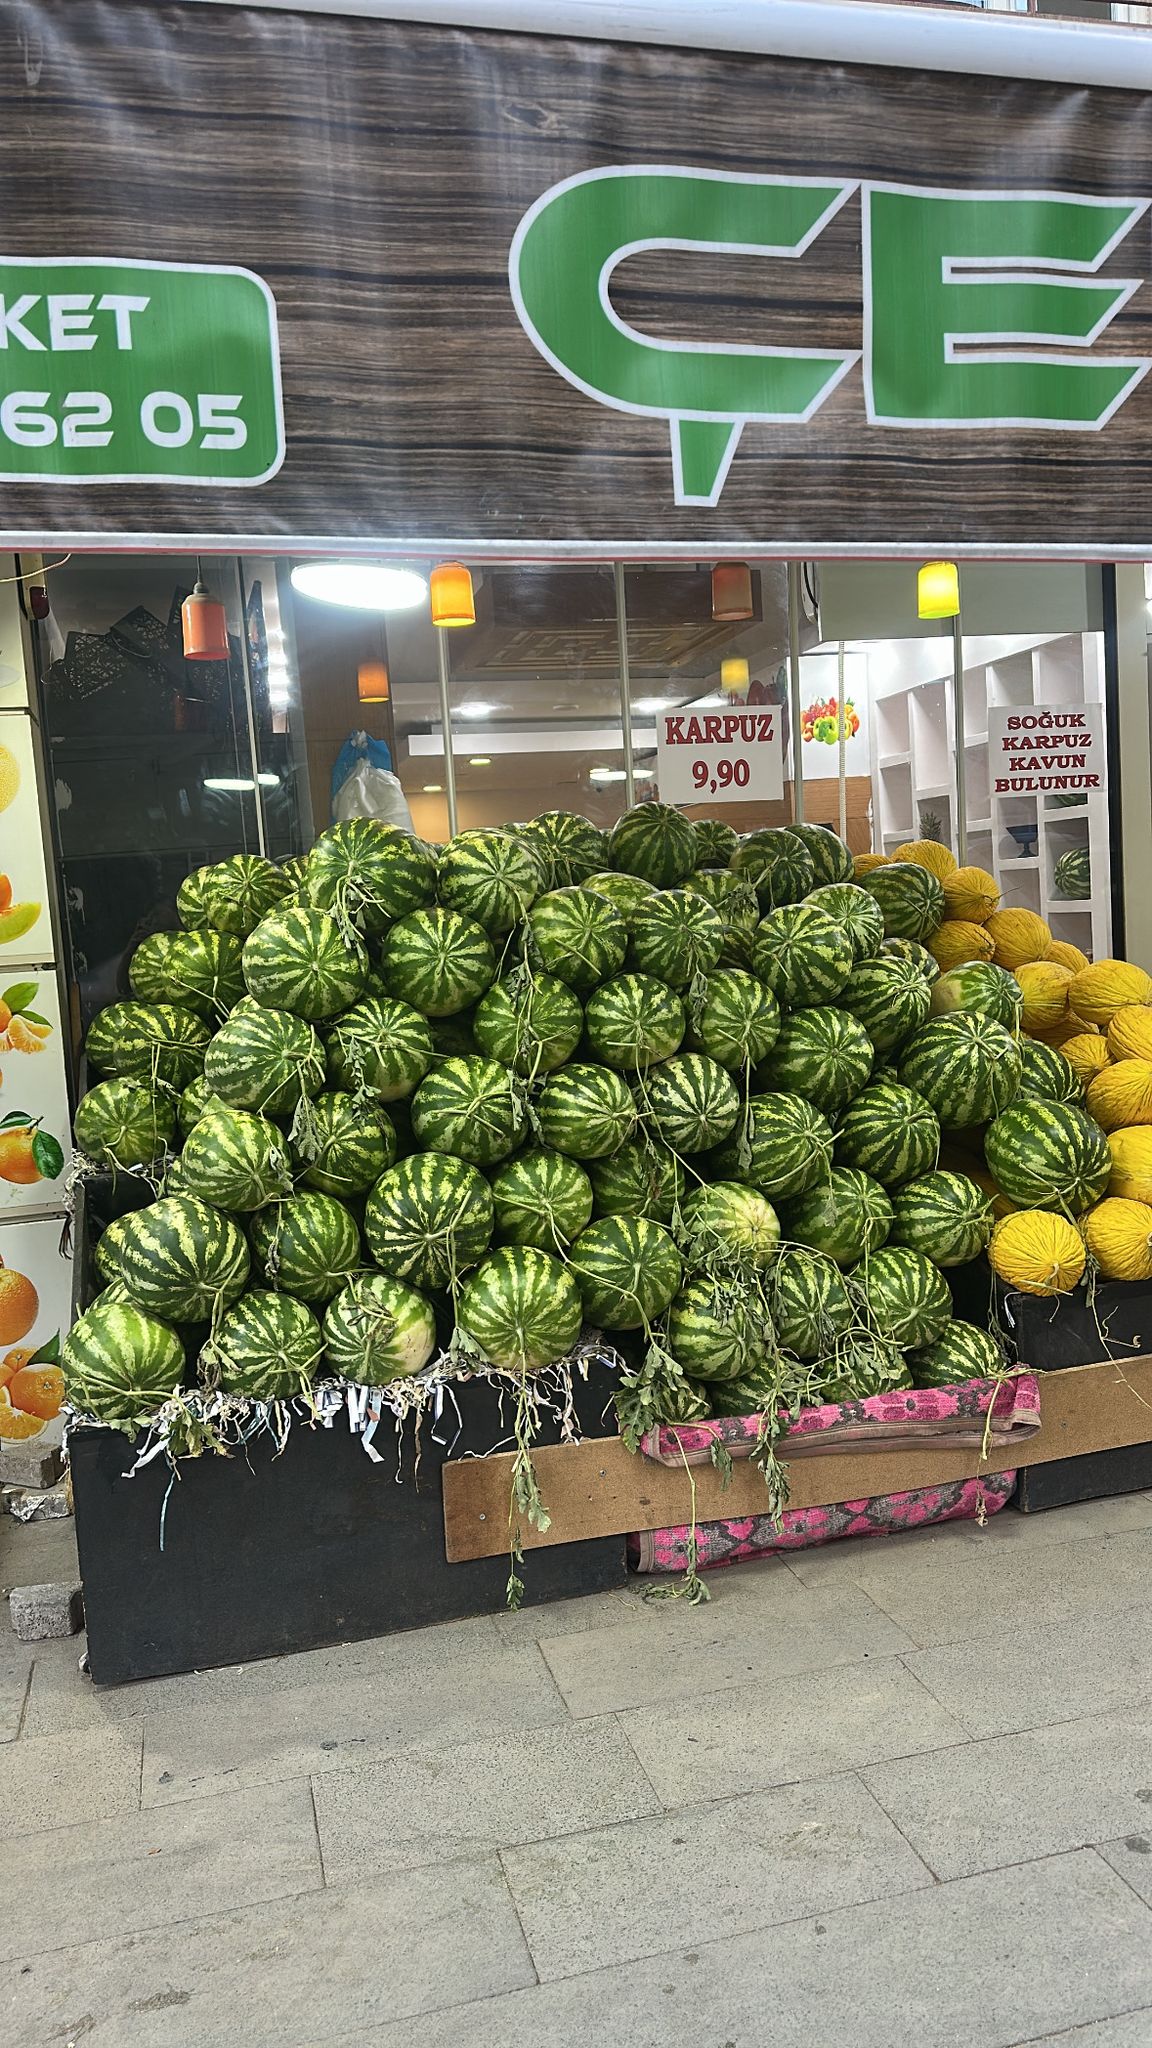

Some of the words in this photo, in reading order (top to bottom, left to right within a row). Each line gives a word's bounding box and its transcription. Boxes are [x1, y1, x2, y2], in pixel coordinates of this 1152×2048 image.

[0, 293, 151, 351] KET
[508, 164, 1152, 507] ÇE
[0, 391, 114, 447] 62
[140, 391, 248, 450] 05
[664, 714, 774, 745] KARPUZ
[1007, 711, 1086, 730] SOĞUK
[1002, 733, 1092, 751] KARPUZ
[692, 759, 750, 794] 9,90
[1008, 754, 1086, 771] KAVUN
[994, 774, 1100, 792] BULUNUR
